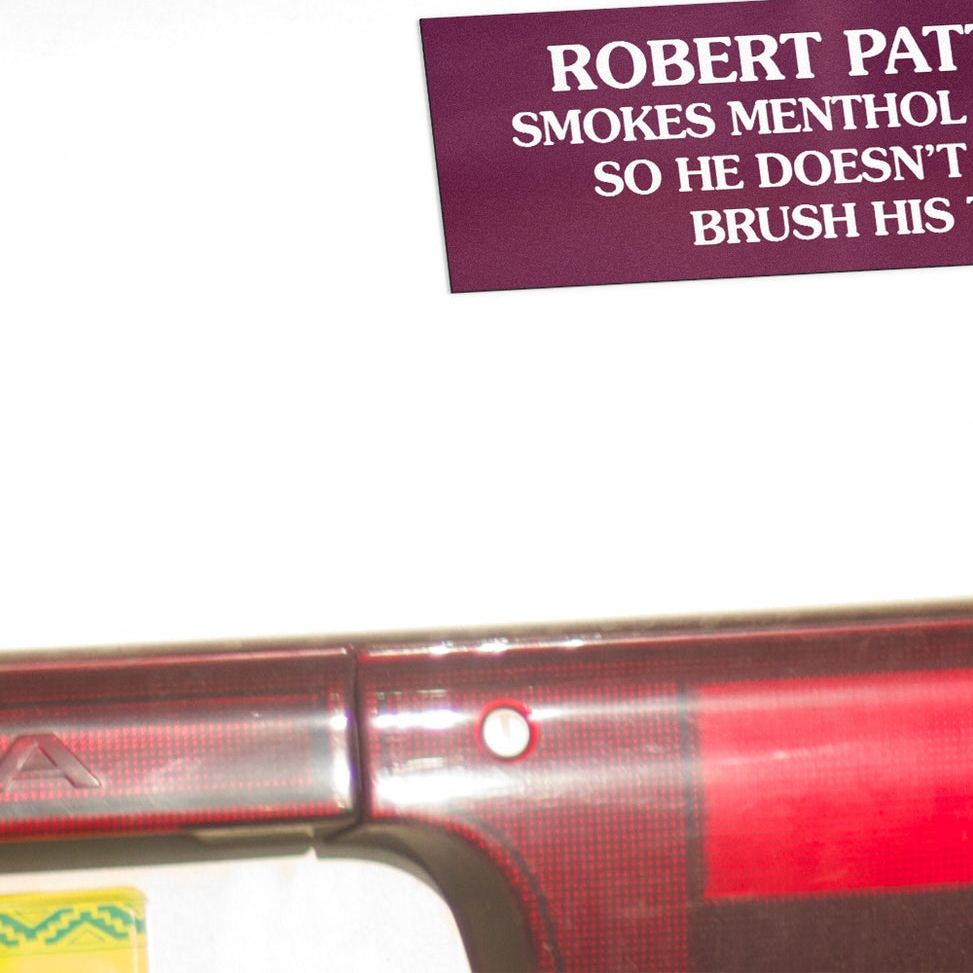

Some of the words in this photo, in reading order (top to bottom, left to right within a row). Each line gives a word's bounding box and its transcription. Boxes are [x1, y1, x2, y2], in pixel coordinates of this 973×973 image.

[546, 31, 823, 92] ROBERT
[511, 101, 716, 148] SMOKES
[729, 89, 968, 136] MENTHOL
[593, 158, 662, 198] SO
[674, 154, 745, 193] HE
[756, 142, 968, 188] DOESN'T
[689, 202, 861, 246] BRUSH
[870, 196, 955, 237] HIS
